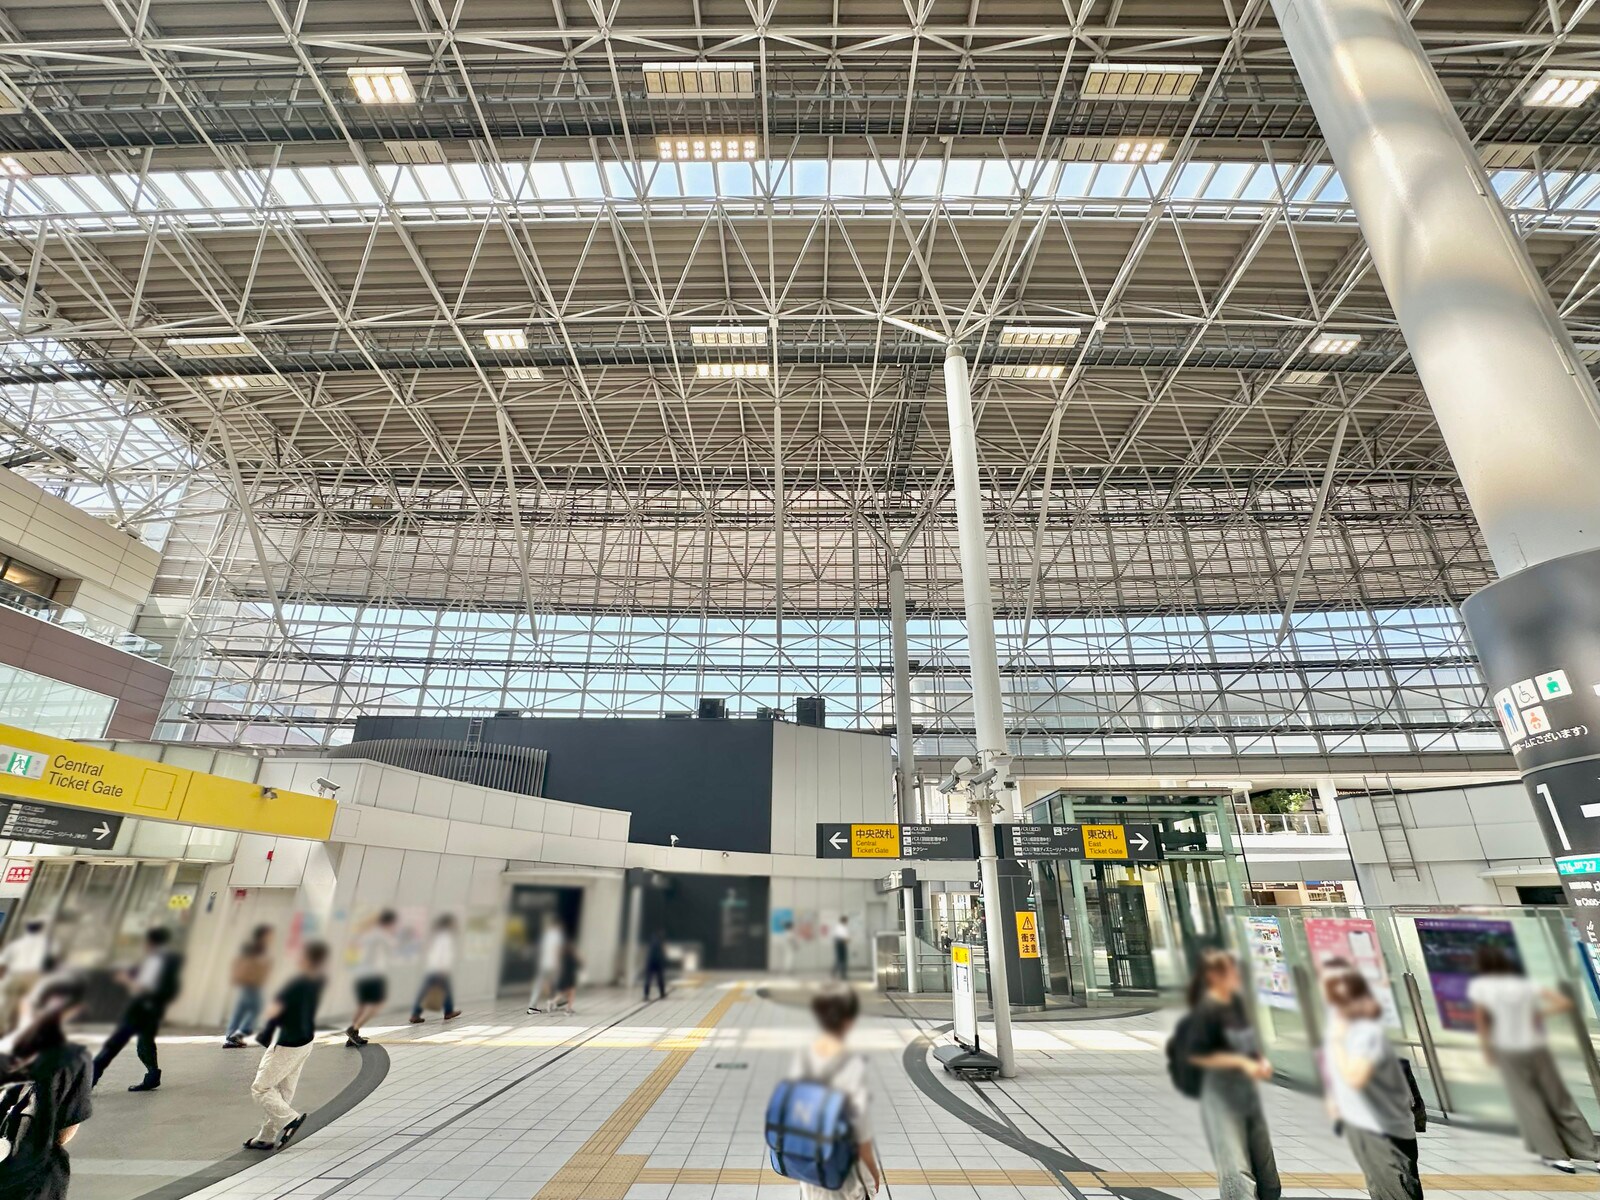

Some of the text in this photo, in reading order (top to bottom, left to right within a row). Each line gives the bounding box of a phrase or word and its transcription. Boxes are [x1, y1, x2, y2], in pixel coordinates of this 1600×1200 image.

[54, 755, 104, 777] Central
[49, 771, 123, 797] Ticket Gate
[1536, 783, 1572, 851] 1
[856, 828, 895, 839] 中央改札
[1087, 829, 1118, 840] 東改札
[1021, 933, 1036, 943] 衝突
[1022, 944, 1038, 953] 注意
